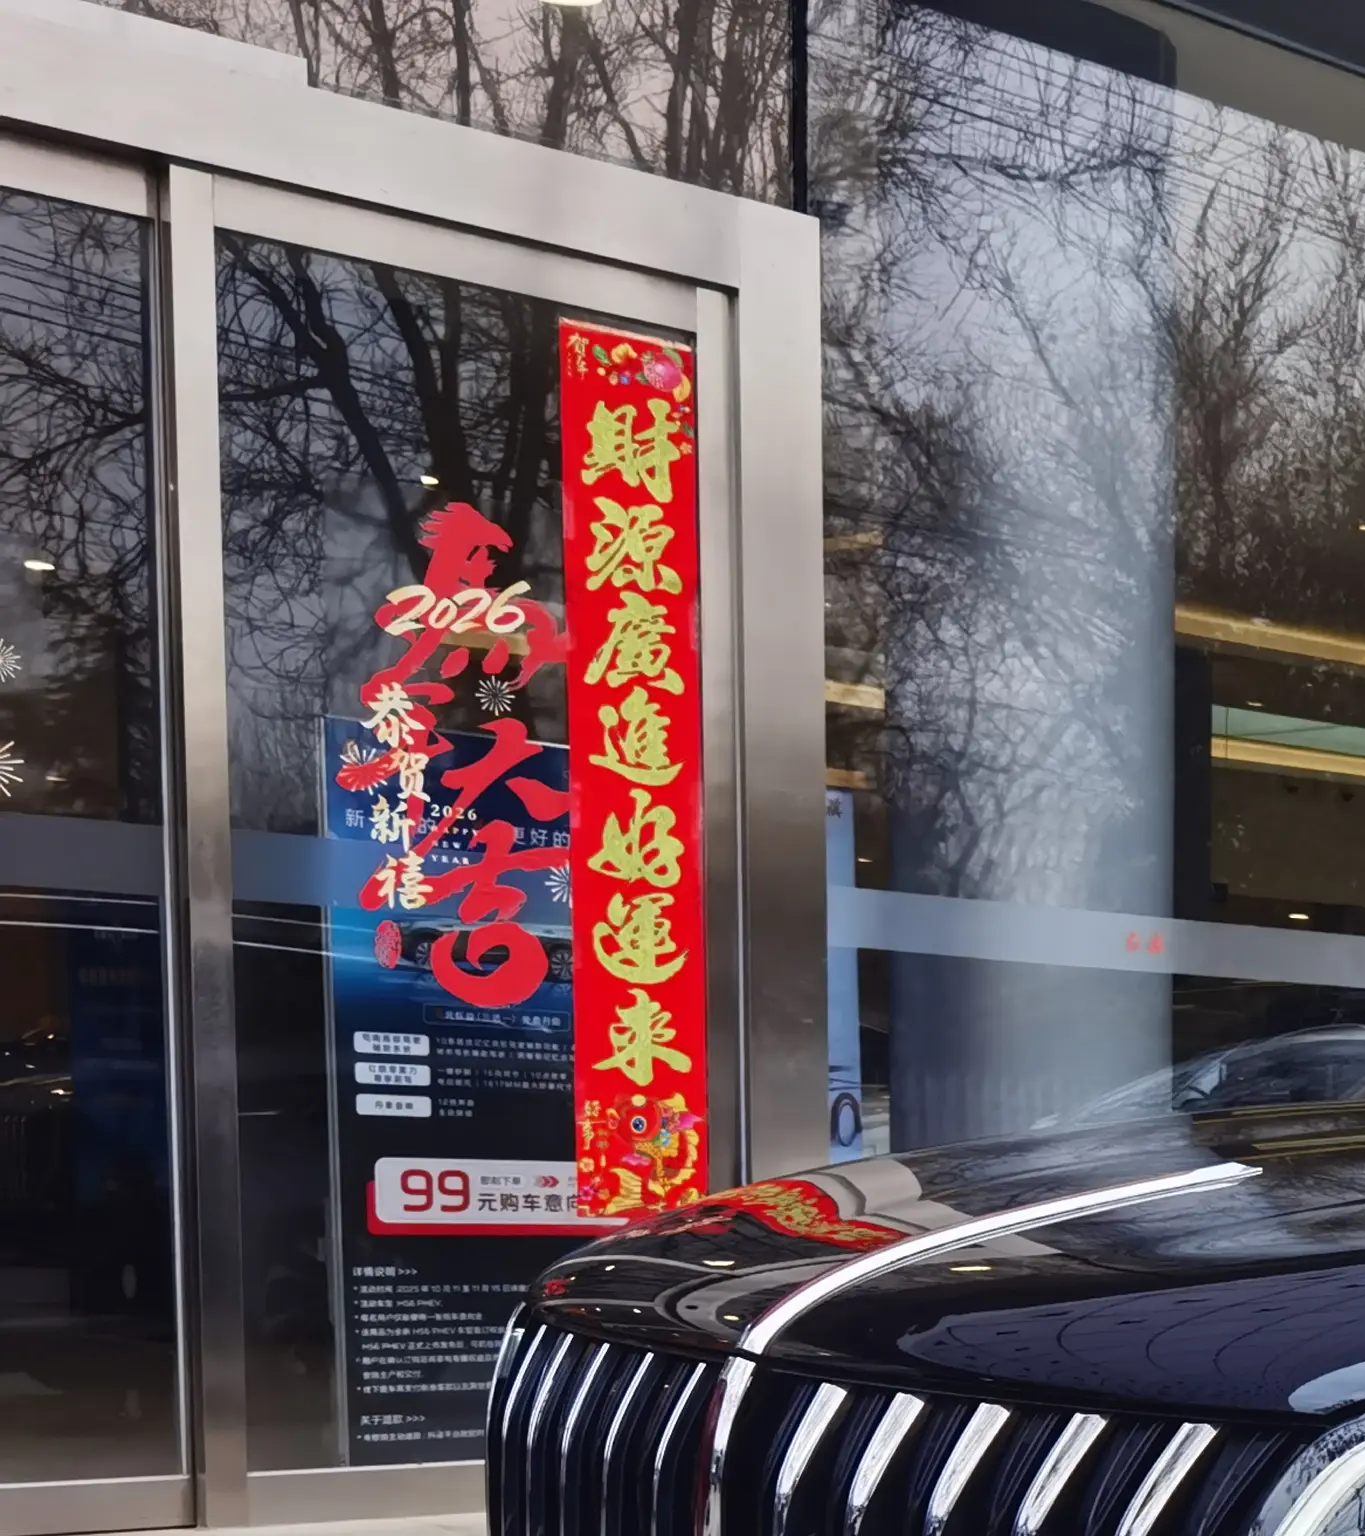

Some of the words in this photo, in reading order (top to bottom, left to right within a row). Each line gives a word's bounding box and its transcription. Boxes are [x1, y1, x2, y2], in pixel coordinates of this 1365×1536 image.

[385, 580, 532, 636] 2026
[359, 682, 434, 910] 恭贺新禧
[430, 804, 478, 821] 2026
[431, 854, 470, 865] YEAR
[400, 1169, 470, 1213] 99
